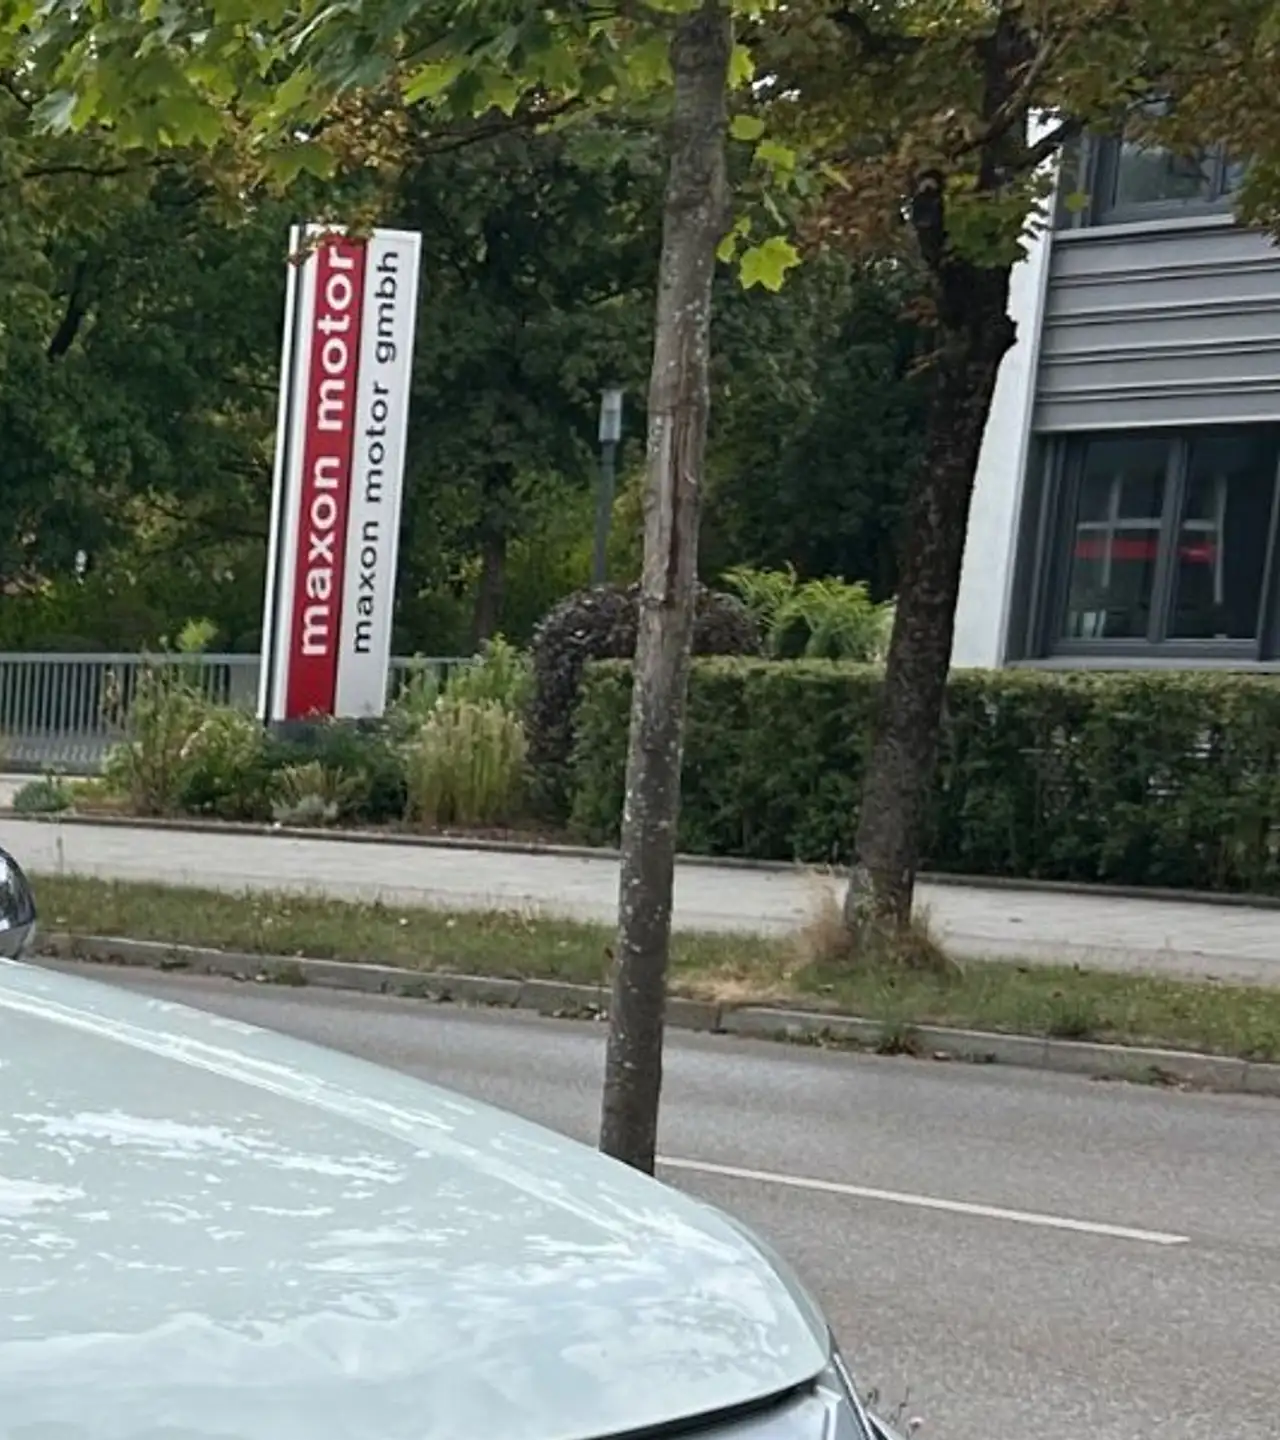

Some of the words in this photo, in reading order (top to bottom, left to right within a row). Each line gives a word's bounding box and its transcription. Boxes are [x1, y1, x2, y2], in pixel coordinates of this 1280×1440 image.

[317, 246, 354, 430] motor
[375, 251, 399, 364] gmbh
[365, 382, 390, 503] motor
[301, 458, 339, 655] maxon
[354, 521, 380, 653] maxon
